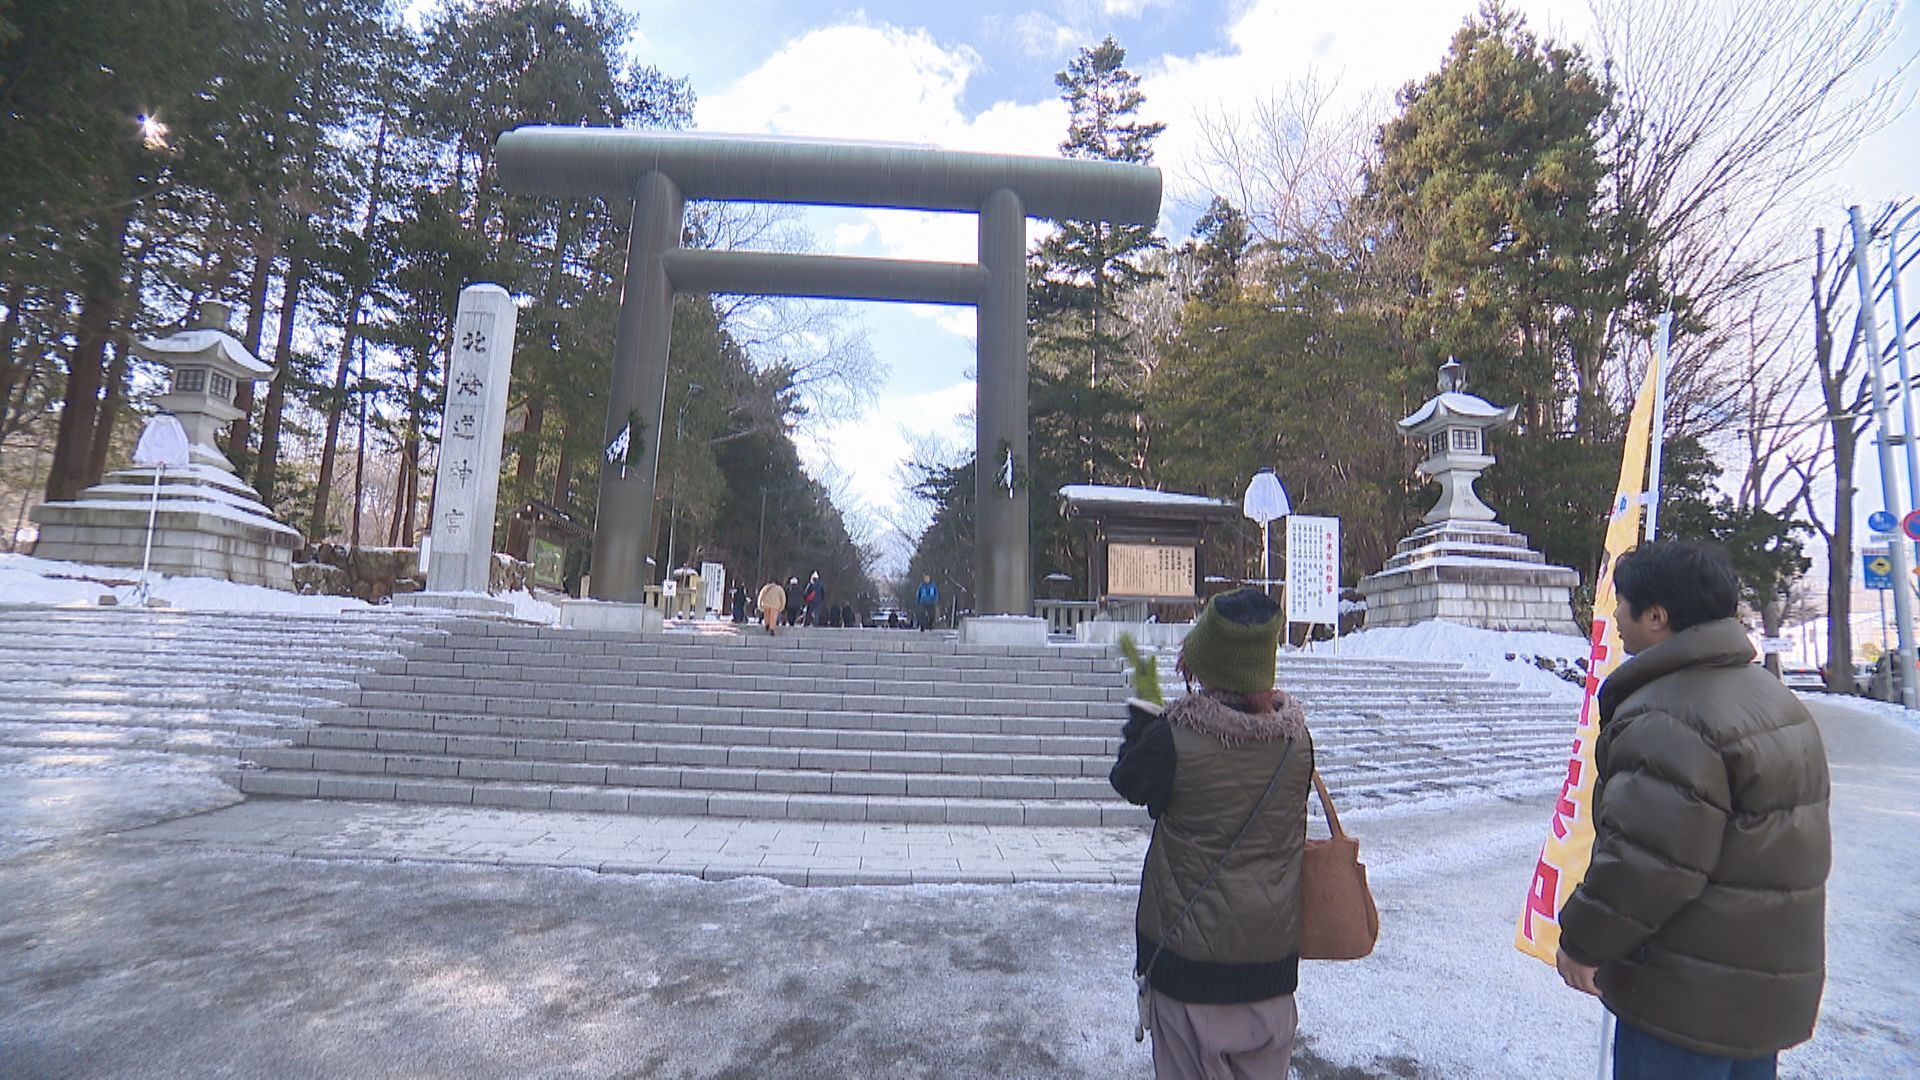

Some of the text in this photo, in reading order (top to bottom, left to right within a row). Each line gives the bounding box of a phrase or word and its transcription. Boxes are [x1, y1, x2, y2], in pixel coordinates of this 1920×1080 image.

[444, 330, 486, 534] 北海道神宮
